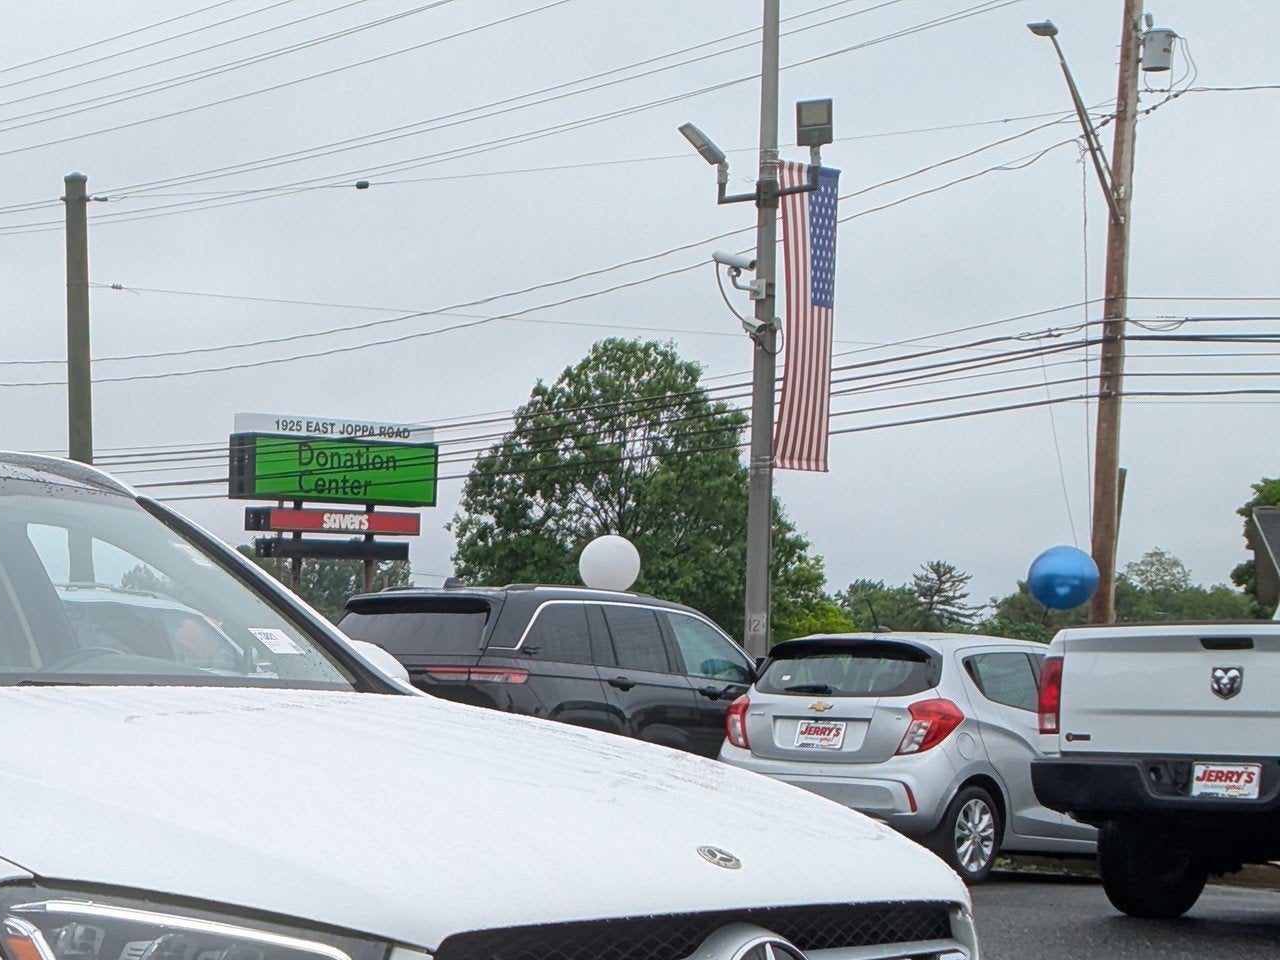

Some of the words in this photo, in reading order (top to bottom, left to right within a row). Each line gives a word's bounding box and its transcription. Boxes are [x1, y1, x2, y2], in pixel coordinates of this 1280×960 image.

[275, 419, 302, 432] 1925
[306, 421, 335, 434] EAST
[339, 423, 375, 437] JOPPA
[379, 426, 411, 439] ROAD
[298, 441, 398, 471] Donation
[298, 471, 373, 496] Center
[322, 512, 369, 530] savers
[800, 725, 842, 737] JERRY'S
[1195, 769, 1256, 784] JERRY'S
